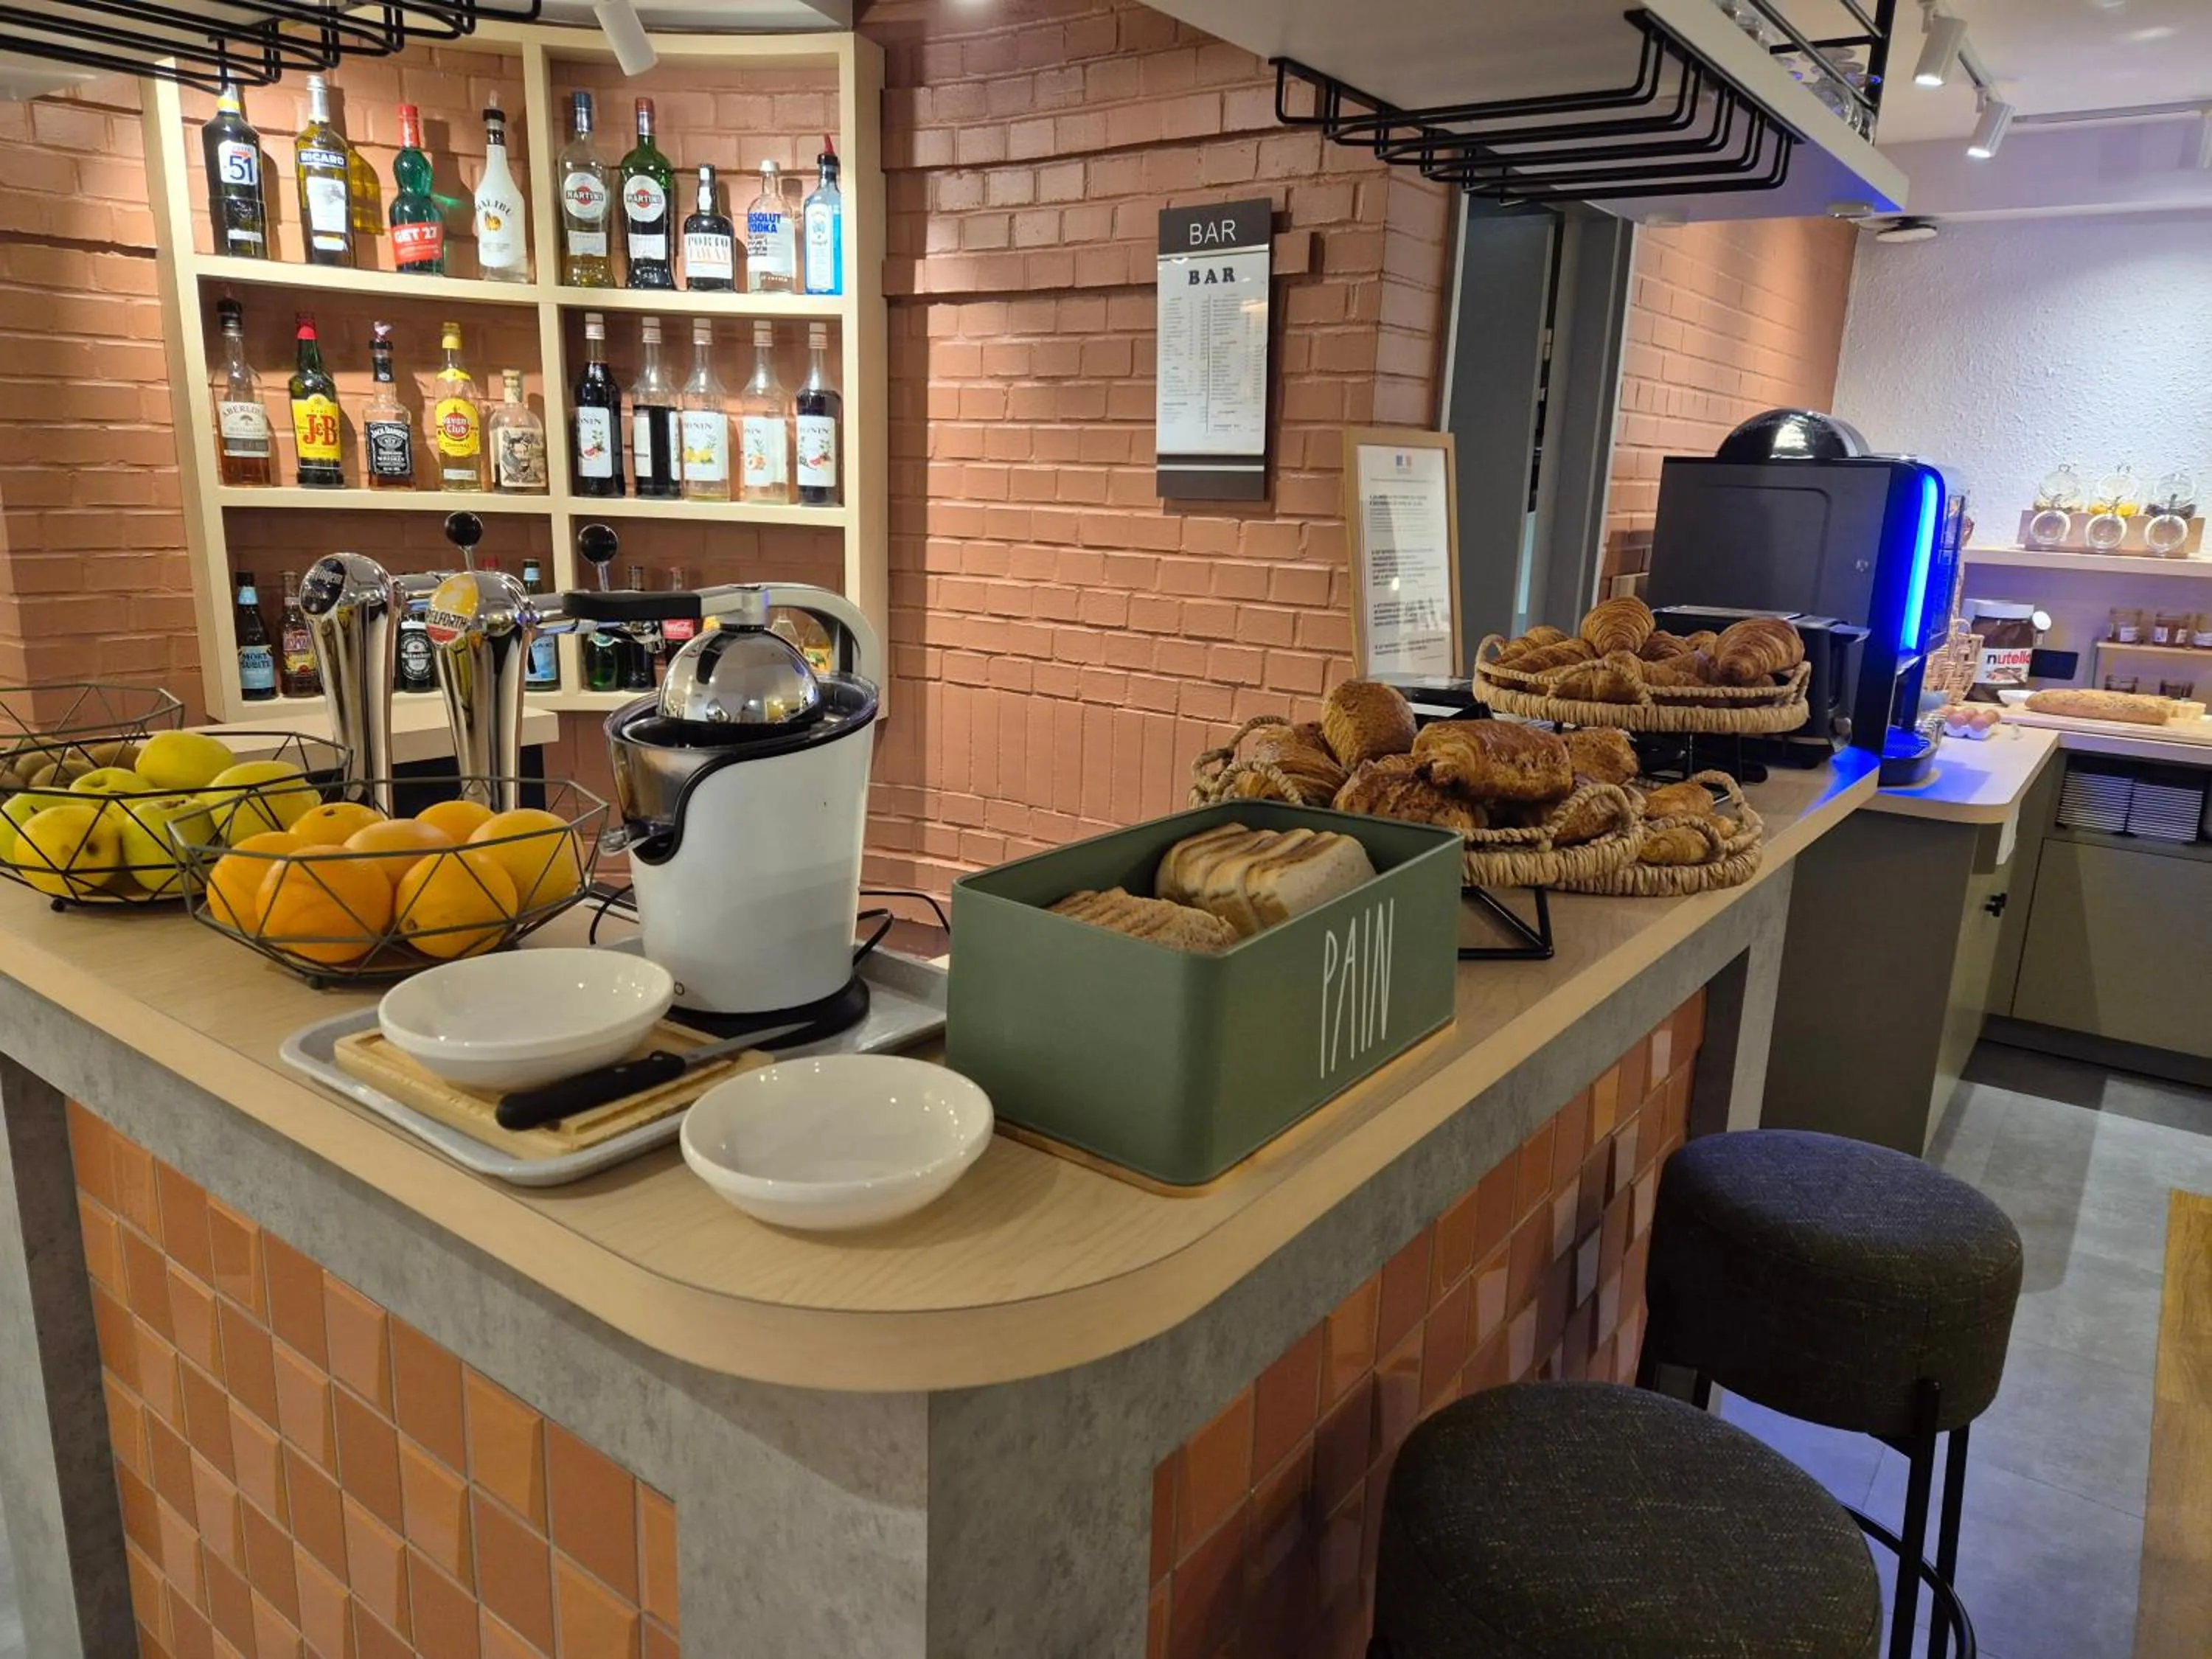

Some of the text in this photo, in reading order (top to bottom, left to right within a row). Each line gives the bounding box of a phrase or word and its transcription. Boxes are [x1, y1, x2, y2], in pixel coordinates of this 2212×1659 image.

[229, 154, 253, 183] 51
[300, 152, 345, 167] RICARD
[566, 189, 604, 201] MARTINI
[626, 194, 663, 204] MARTINI
[394, 226, 437, 244] GET 27
[688, 235, 729, 248] PORTO
[1189, 219, 1237, 246] BAR
[1188, 266, 1236, 286] BAR
[1321, 897, 1394, 1079] PAIN
